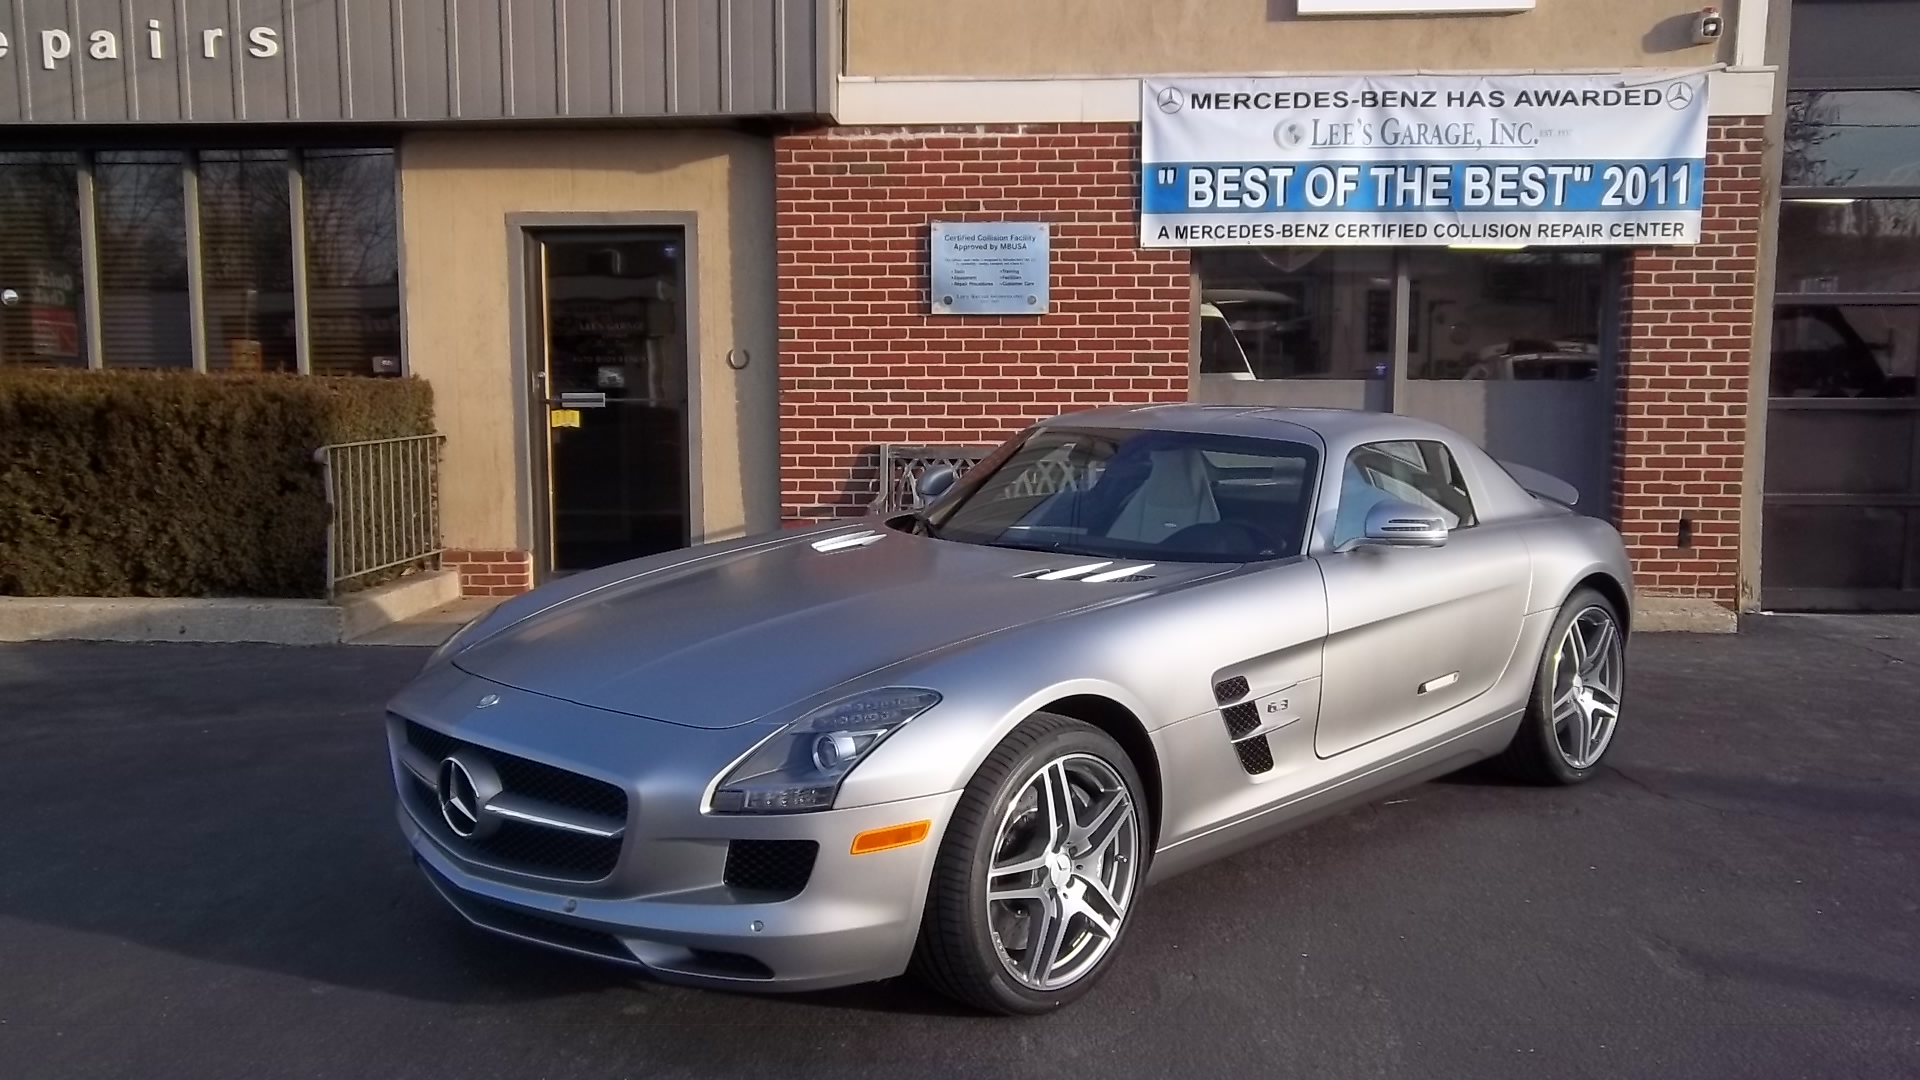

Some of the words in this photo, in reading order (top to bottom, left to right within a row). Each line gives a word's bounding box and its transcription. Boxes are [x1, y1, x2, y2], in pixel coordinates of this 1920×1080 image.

[1191, 90, 1437, 110] MERCEDES-BENZ
[1446, 90, 1505, 108] HAS
[1513, 89, 1662, 107] AWARDED
[1311, 118, 1373, 146] LEE'S
[1380, 117, 1483, 150] GARAGE,
[1489, 118, 1539, 146] INC.
[1188, 165, 1295, 208] BEST
[1305, 165, 1360, 208] OF
[1370, 165, 1452, 207] THE
[1601, 163, 1690, 207] 2011
[944, 234, 976, 242] Certified
[977, 234, 1009, 242] Collision
[1010, 234, 1037, 243] Facility
[1157, 225, 1170, 240] A
[1175, 223, 1329, 240] MERCEDES-BENZ
[1334, 223, 1428, 239] CERTIFIED
[1433, 222, 1532, 239] COLLISION
[1537, 222, 1604, 238] REPAIR
[1609, 222, 1685, 238] CENTER
[953, 243, 988, 252] Approved
[989, 242, 999, 252] by
[1000, 243, 1028, 251] MBUSA
[1267, 699, 1289, 713] 6.3
